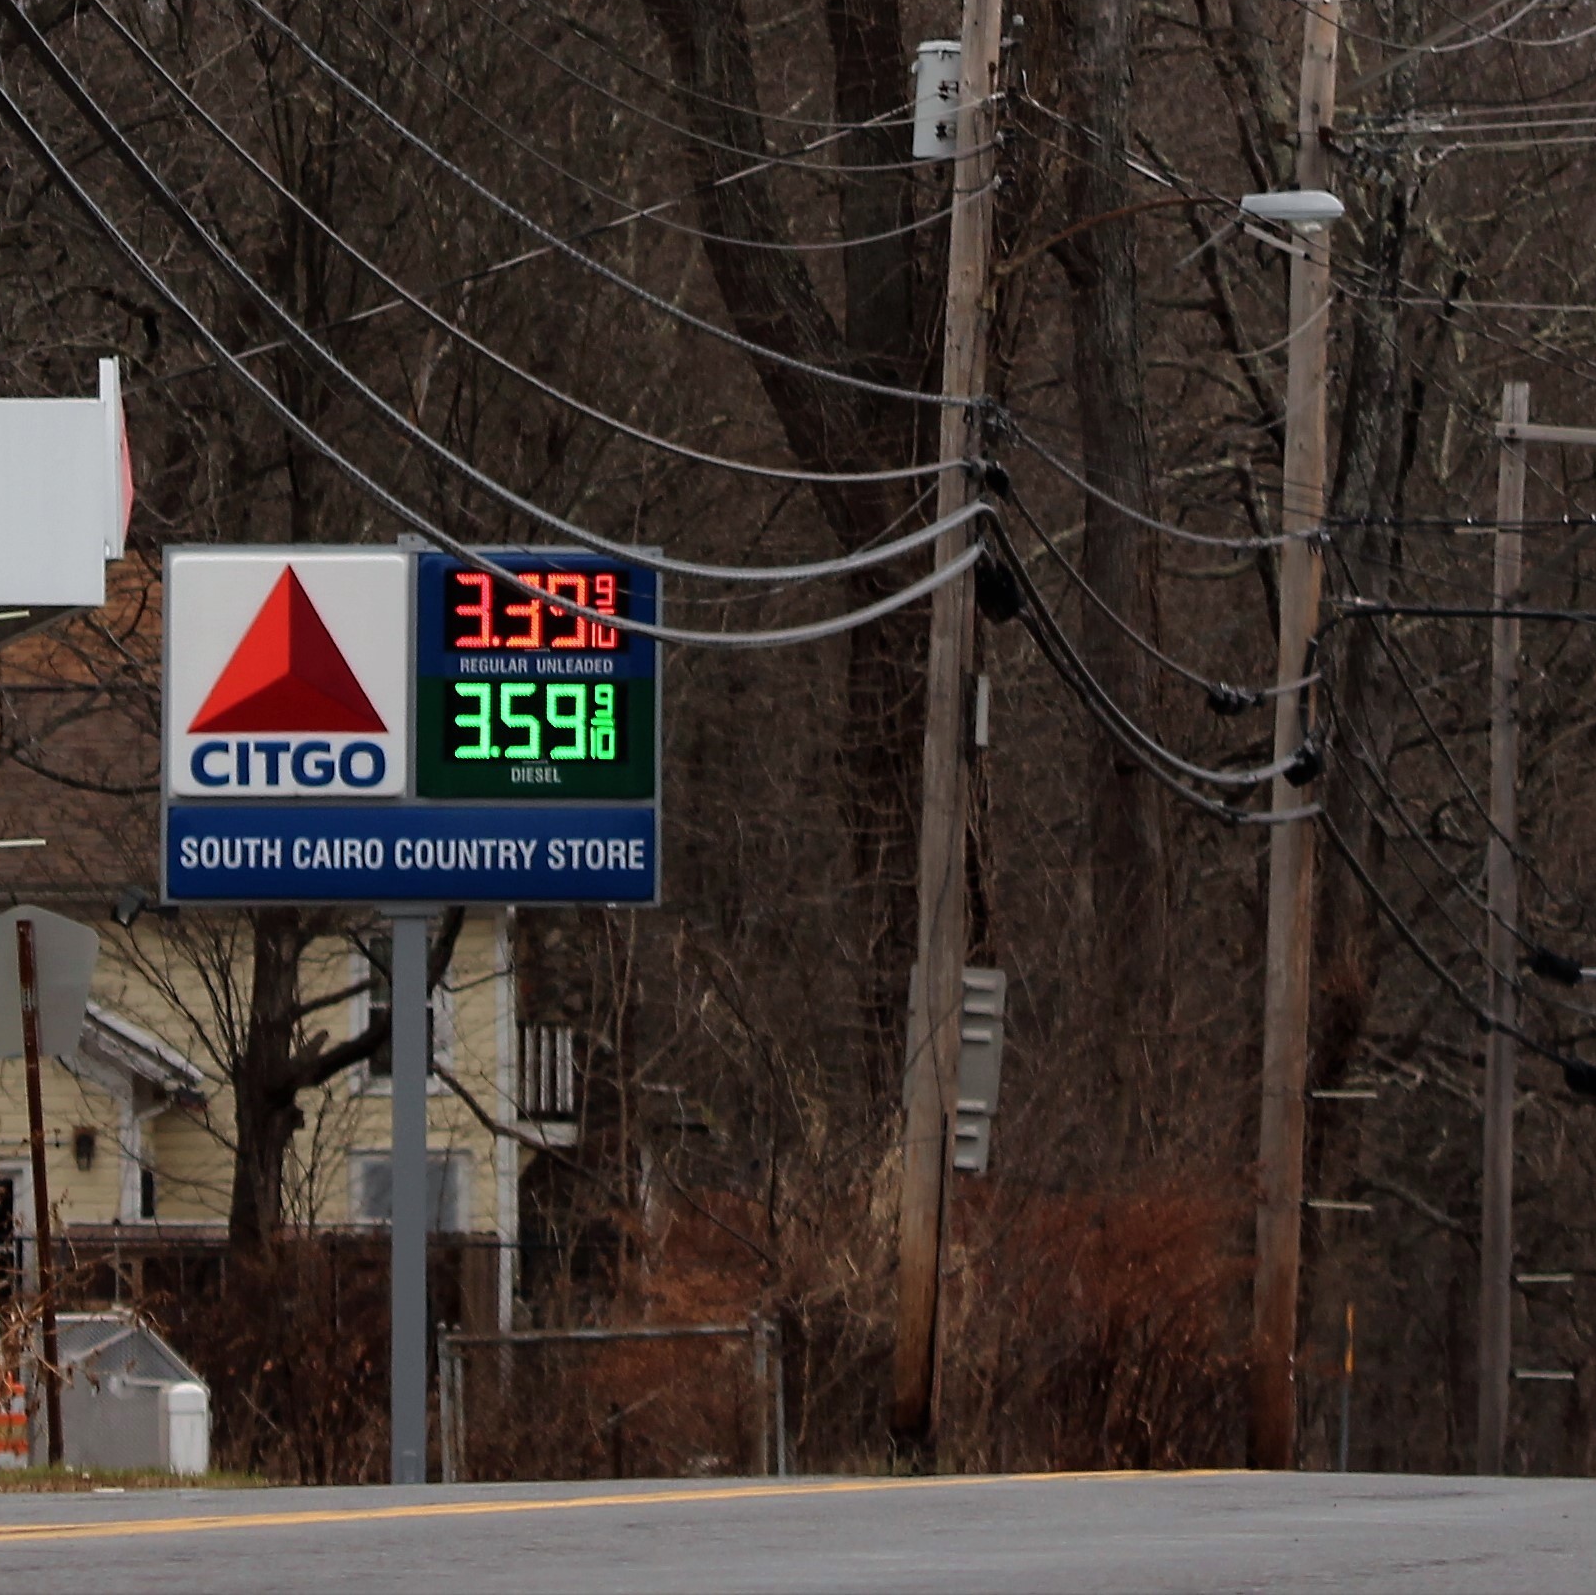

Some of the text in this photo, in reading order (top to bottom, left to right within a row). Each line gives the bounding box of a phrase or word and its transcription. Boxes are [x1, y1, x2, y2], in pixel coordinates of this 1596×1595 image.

[455, 572, 587, 649] 3.39
[460, 657, 614, 675] REGULAR UNLEADED
[454, 682, 587, 760] 3.59
[190, 741, 386, 787] CITGO
[510, 767, 562, 784] DIESEL
[179, 836, 646, 871] SOUTH CAIRO COUNTRY STORE
